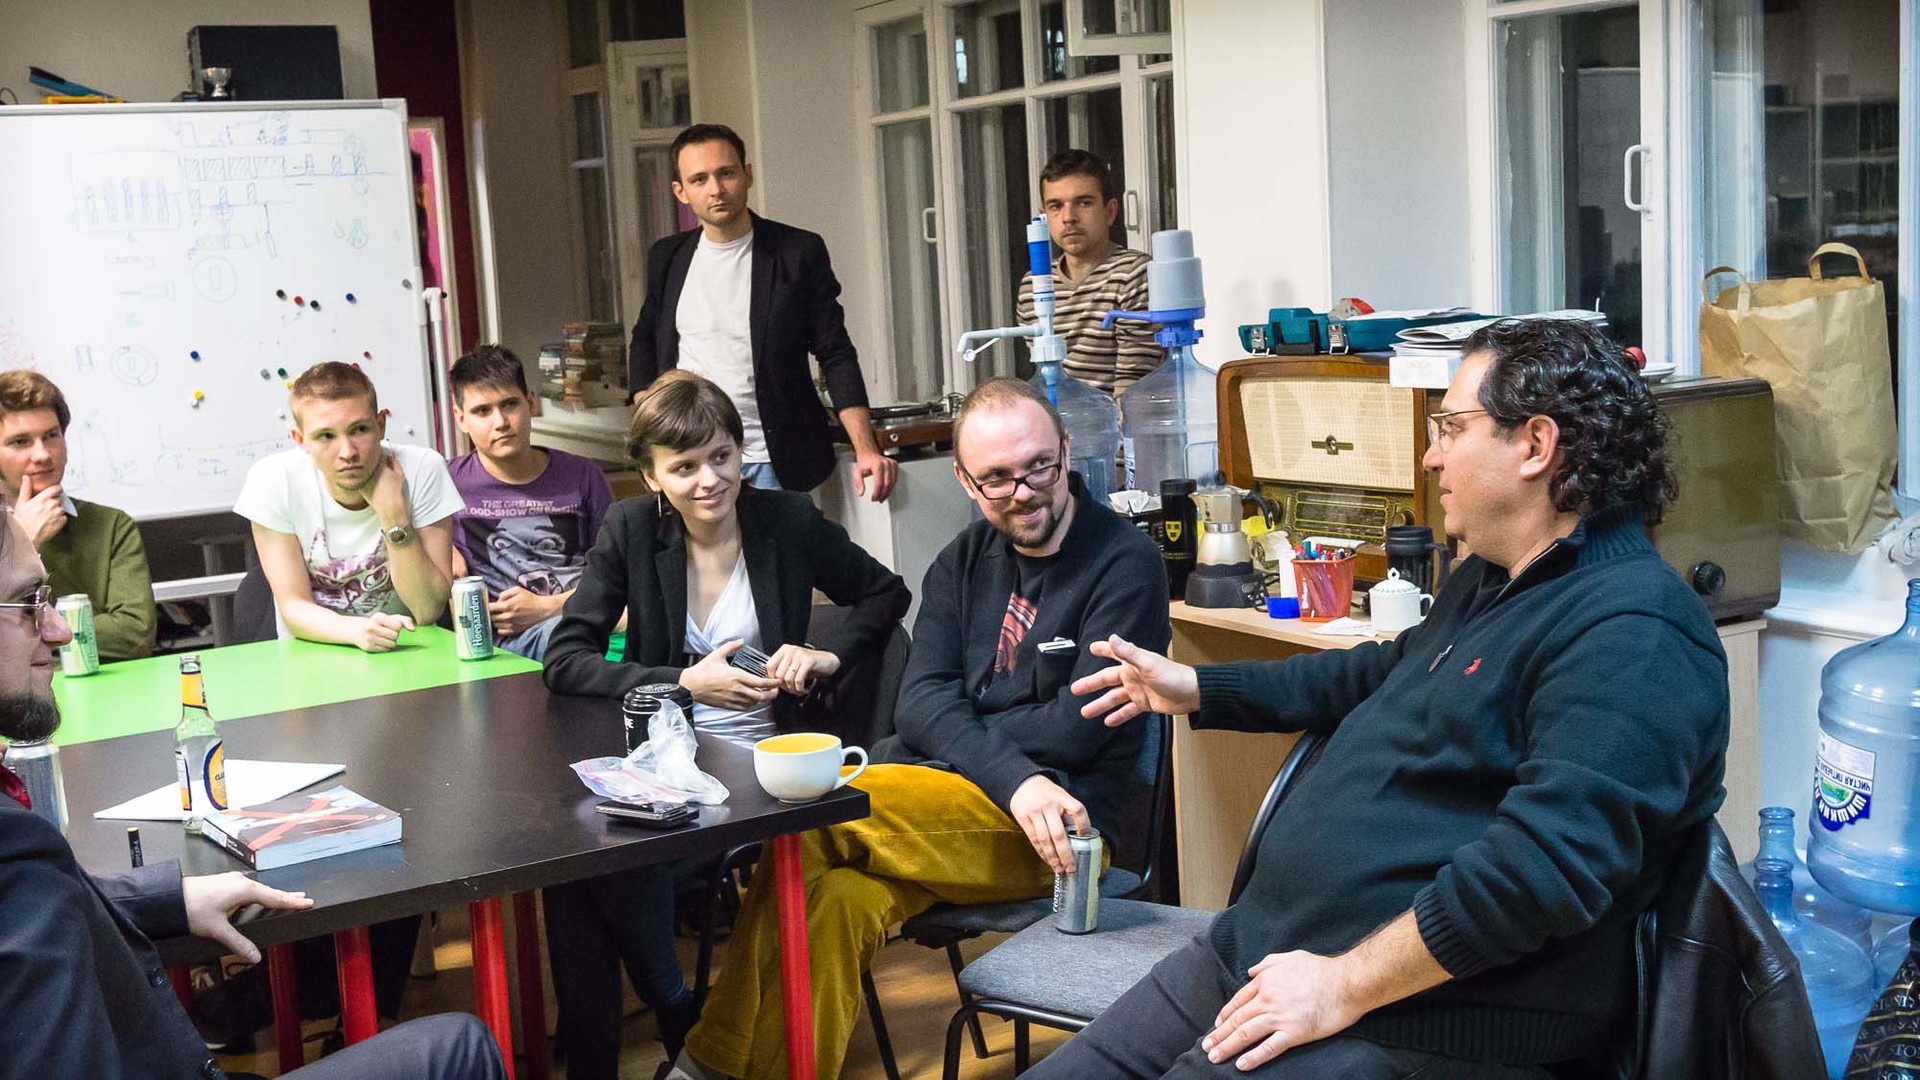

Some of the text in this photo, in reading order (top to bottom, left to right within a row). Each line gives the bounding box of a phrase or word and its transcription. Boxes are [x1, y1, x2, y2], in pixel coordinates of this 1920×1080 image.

[482, 499, 502, 508] THE
[469, 594, 484, 647] Hoegaarden
[1845, 777, 1871, 792] ЧИСТАЯ
[1818, 793, 1867, 823] ШИШКИН
